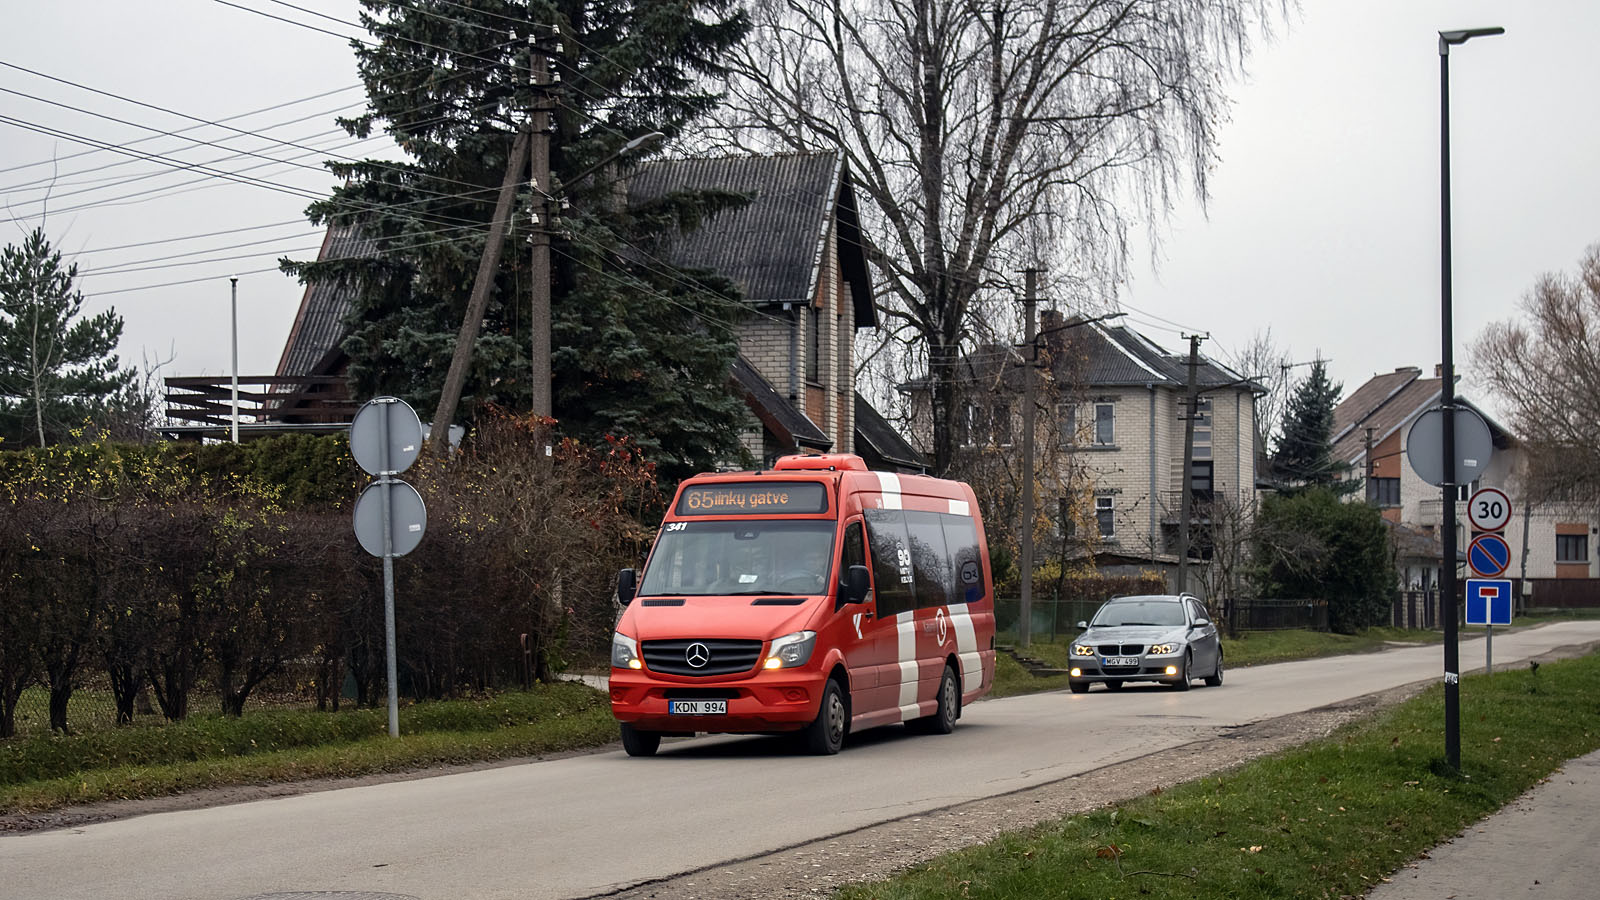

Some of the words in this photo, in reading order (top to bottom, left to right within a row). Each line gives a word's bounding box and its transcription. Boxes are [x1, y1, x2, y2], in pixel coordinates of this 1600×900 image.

[688, 491, 713, 509] 65
[1478, 501, 1503, 519] 30
[666, 522, 688, 532] 341
[675, 702, 698, 713] KDN
[704, 702, 725, 713] 994
